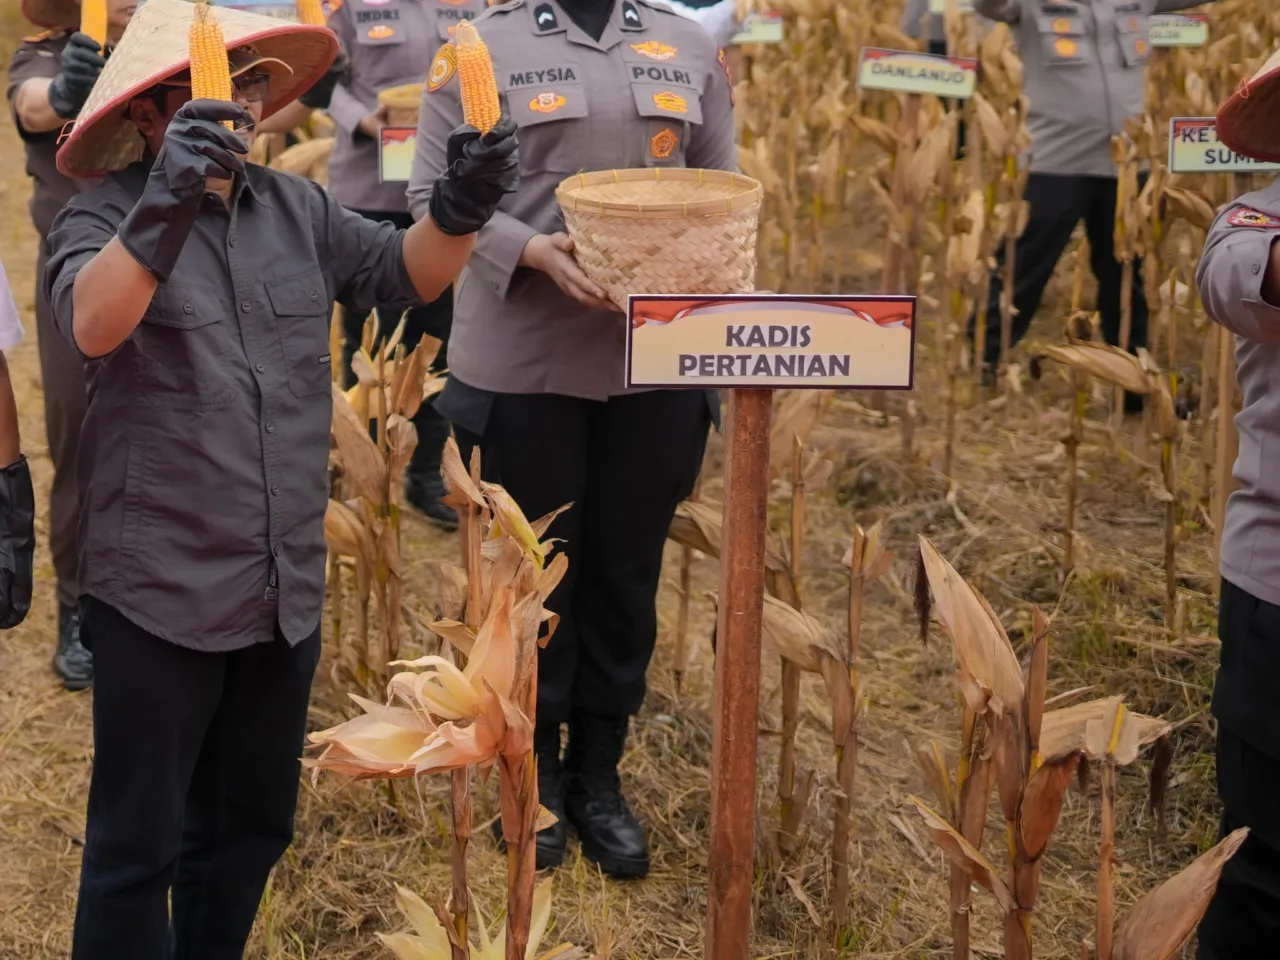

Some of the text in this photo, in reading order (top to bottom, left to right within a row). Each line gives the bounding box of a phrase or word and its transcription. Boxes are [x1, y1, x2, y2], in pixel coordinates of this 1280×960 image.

[356, 10, 400, 24] INDRI
[436, 8, 476, 21] POLRI
[510, 67, 576, 87] MEYSIA
[632, 66, 691, 85] POLRI
[871, 62, 965, 82] DANLANUD
[1205, 149, 1261, 164] SUM
[726, 325, 811, 347] KADIS
[679, 354, 851, 377] PERTANIAN
